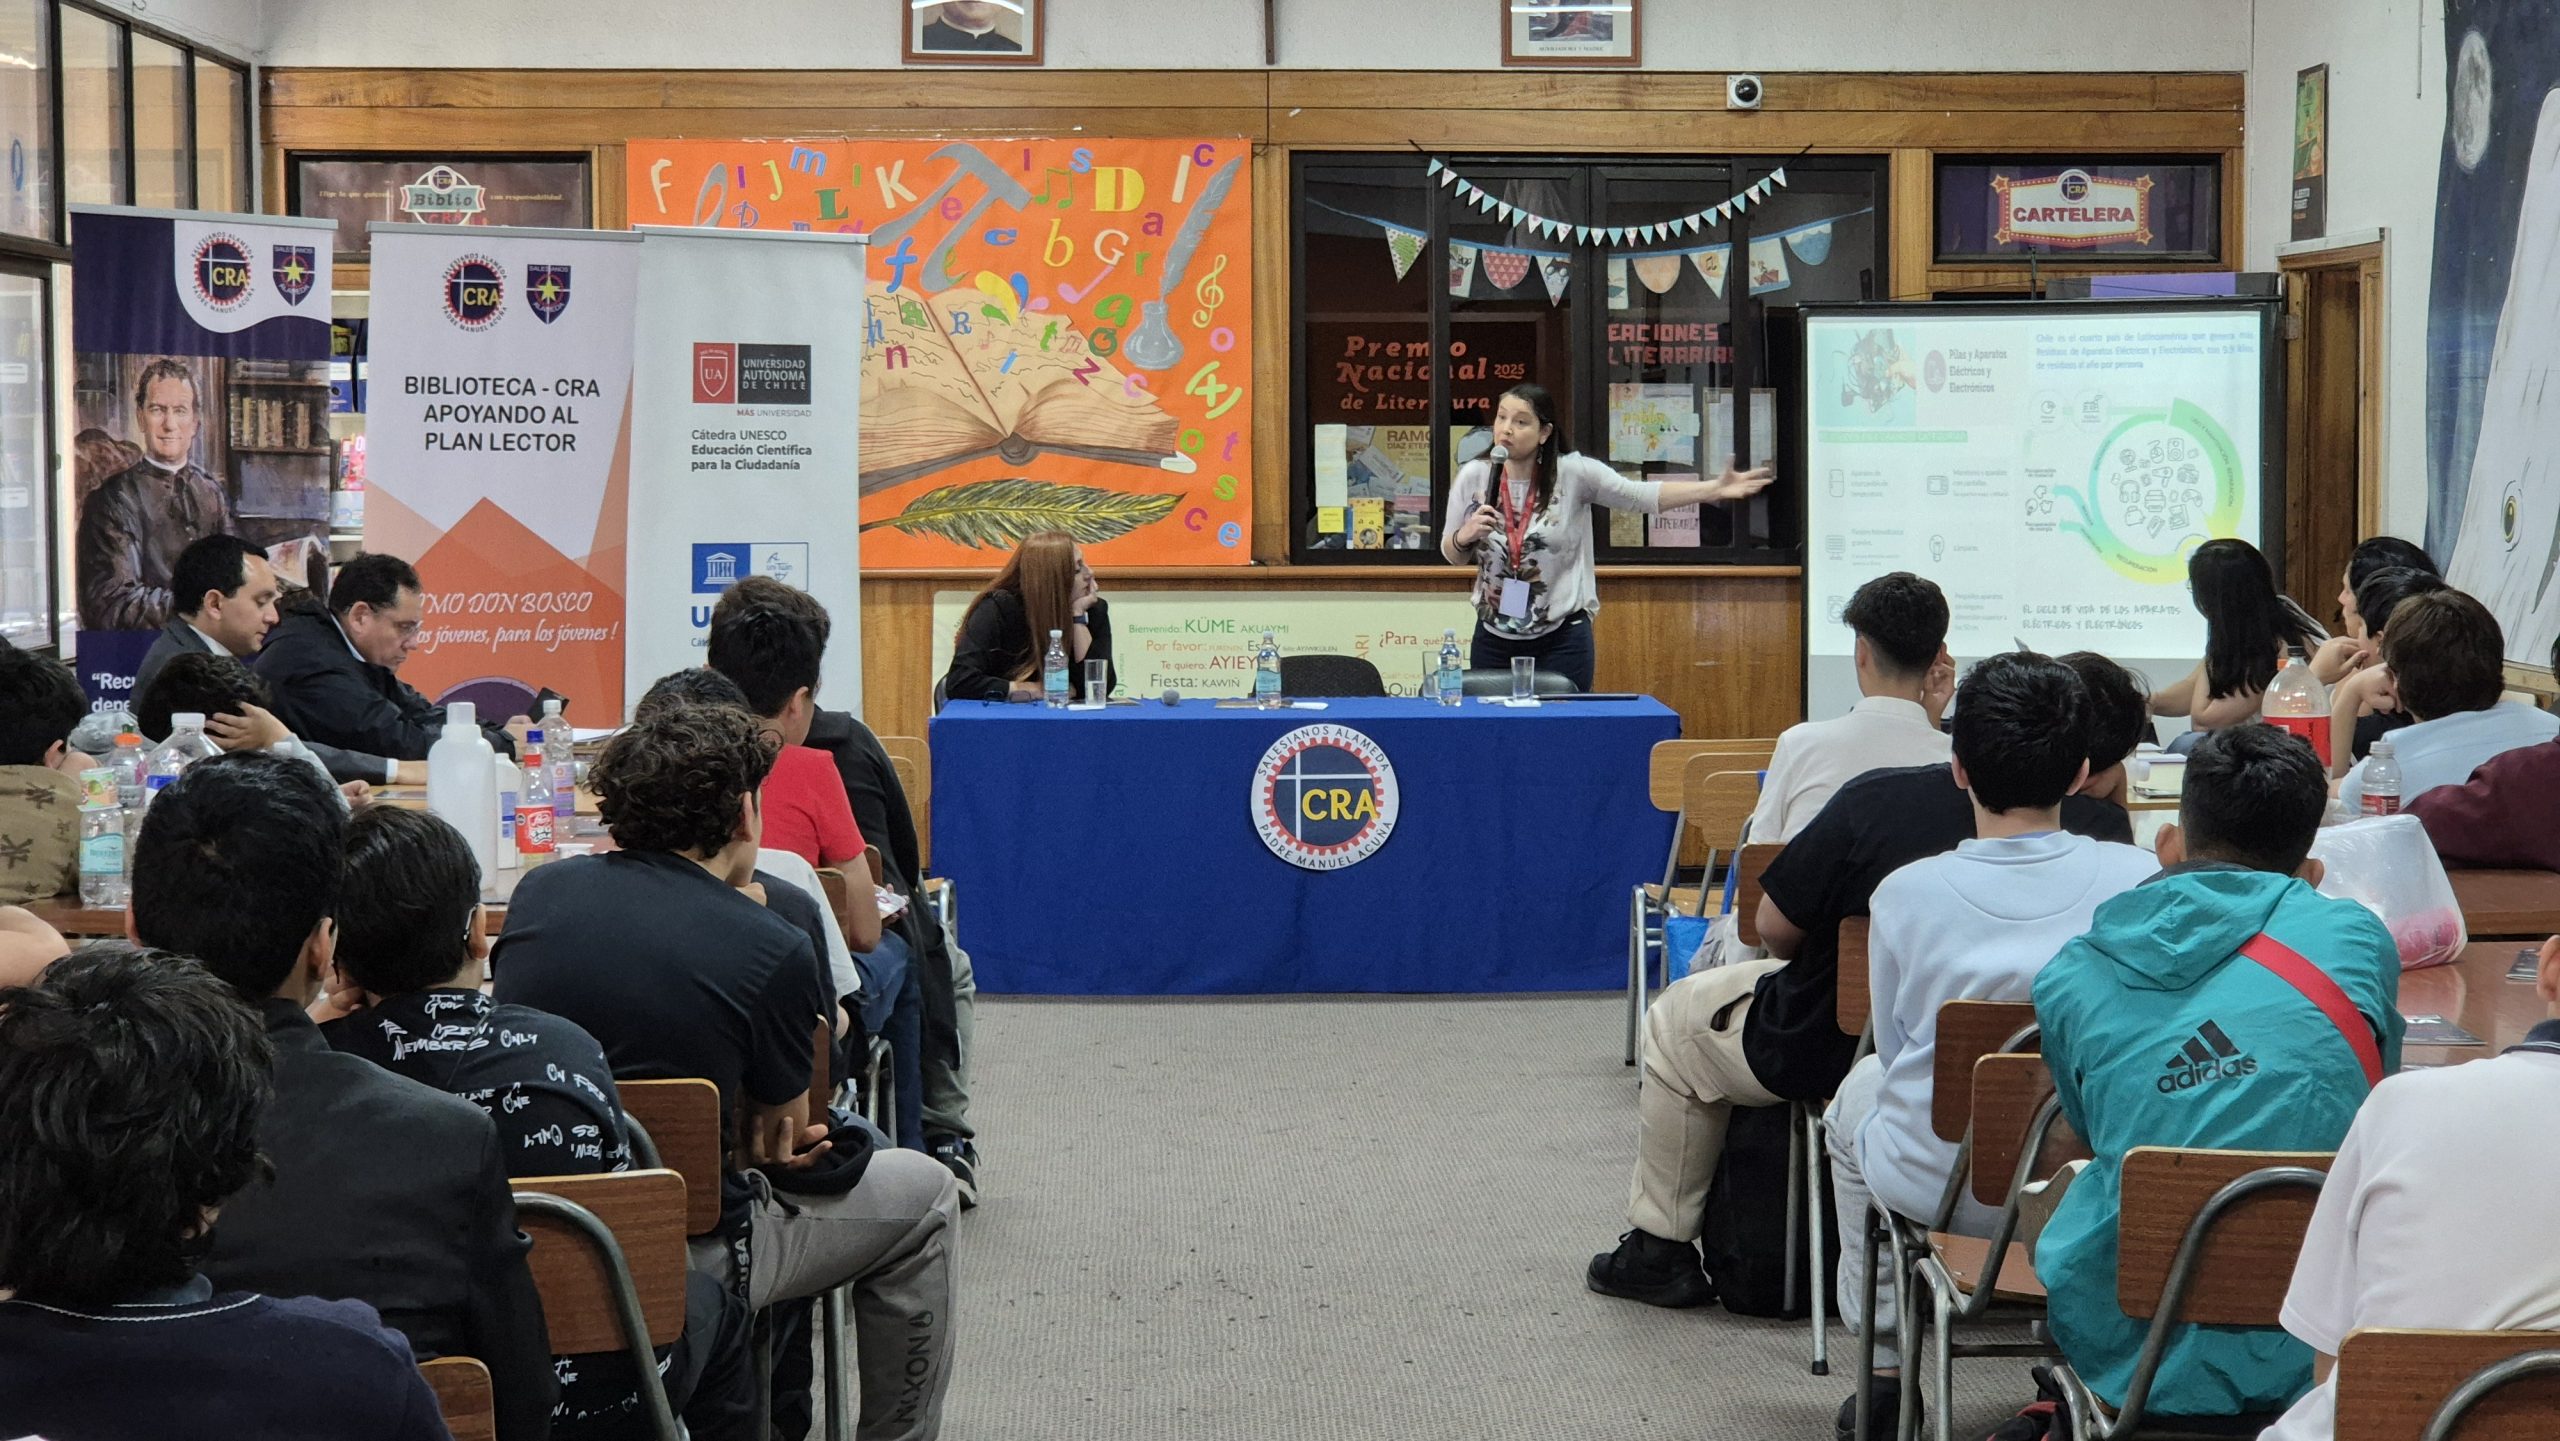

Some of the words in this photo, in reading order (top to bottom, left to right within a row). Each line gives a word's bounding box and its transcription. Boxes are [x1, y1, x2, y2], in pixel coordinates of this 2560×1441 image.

[875, 160, 917, 208] K
[1091, 167, 1145, 212] D
[2070, 185, 2088, 194] CRA
[414, 193, 474, 207] Biblio
[2013, 207, 2135, 223] CARTELERA
[1043, 218, 1075, 268] b
[1094, 229, 1130, 266] G
[212, 266, 248, 287] CRA
[463, 287, 500, 307] CRA
[1344, 335, 1468, 358] Premo
[1949, 348, 1967, 360] Pilas
[1974, 349, 2007, 362] Aparatos
[743, 358, 806, 369] UNIVERSIDAD
[1494, 363, 1526, 380] 2025
[1949, 365, 1985, 377] Eléctricos
[1986, 367, 1992, 379] y
[705, 368, 723, 380] UA
[743, 368, 807, 381] AUTÓNOMA
[404, 375, 537, 396] BIBLIOTECA
[555, 378, 601, 398] CRA
[742, 381, 758, 390] DE
[765, 381, 807, 391] CHILE
[1949, 382, 1995, 393] Electrónicos
[1340, 393, 1364, 410] de
[1376, 393, 1491, 411] Literura
[423, 404, 547, 424] APOYANDO
[551, 406, 579, 424] AL
[757, 408, 812, 418] UNIVERSIDAD
[425, 432, 483, 451] PLAN
[490, 432, 577, 452] LECTOR
[691, 429, 737, 441] Cátedra
[739, 430, 788, 441] UNESCO
[691, 444, 754, 456] Educación
[756, 444, 813, 456] Científica
[691, 461, 718, 473] para
[720, 459, 732, 470] la
[735, 459, 801, 471] Ciudadanía
[468, 591, 519, 614] DON
[521, 591, 594, 614] BOSCO
[1185, 616, 1235, 634] KÜME
[424, 624, 489, 655] jóvenes,
[492, 626, 531, 654] para
[535, 618, 557, 642] los
[546, 623, 608, 653] jóvenes
[1379, 630, 1418, 648] ¿Para
[1147, 640, 1168, 652] Por
[1172, 640, 1208, 652] favor:
[1161, 660, 1172, 670] Te
[1174, 661, 1208, 672] quiero:
[1150, 673, 1198, 689] Fiesta:
[1258, 726, 1329, 776] SALESIANOS
[1336, 727, 1390, 772] ALAMEDA
[1302, 788, 1380, 821] CRA
[1260, 824, 1293, 860] PADRE
[1296, 855, 1354, 869] MANUEL
[1359, 822, 1392, 859] ACUÑA
[2157, 1058, 2258, 1094] adidas
[937, 1145, 954, 1154] NIKE
[892, 1335, 932, 1425] NIXON
